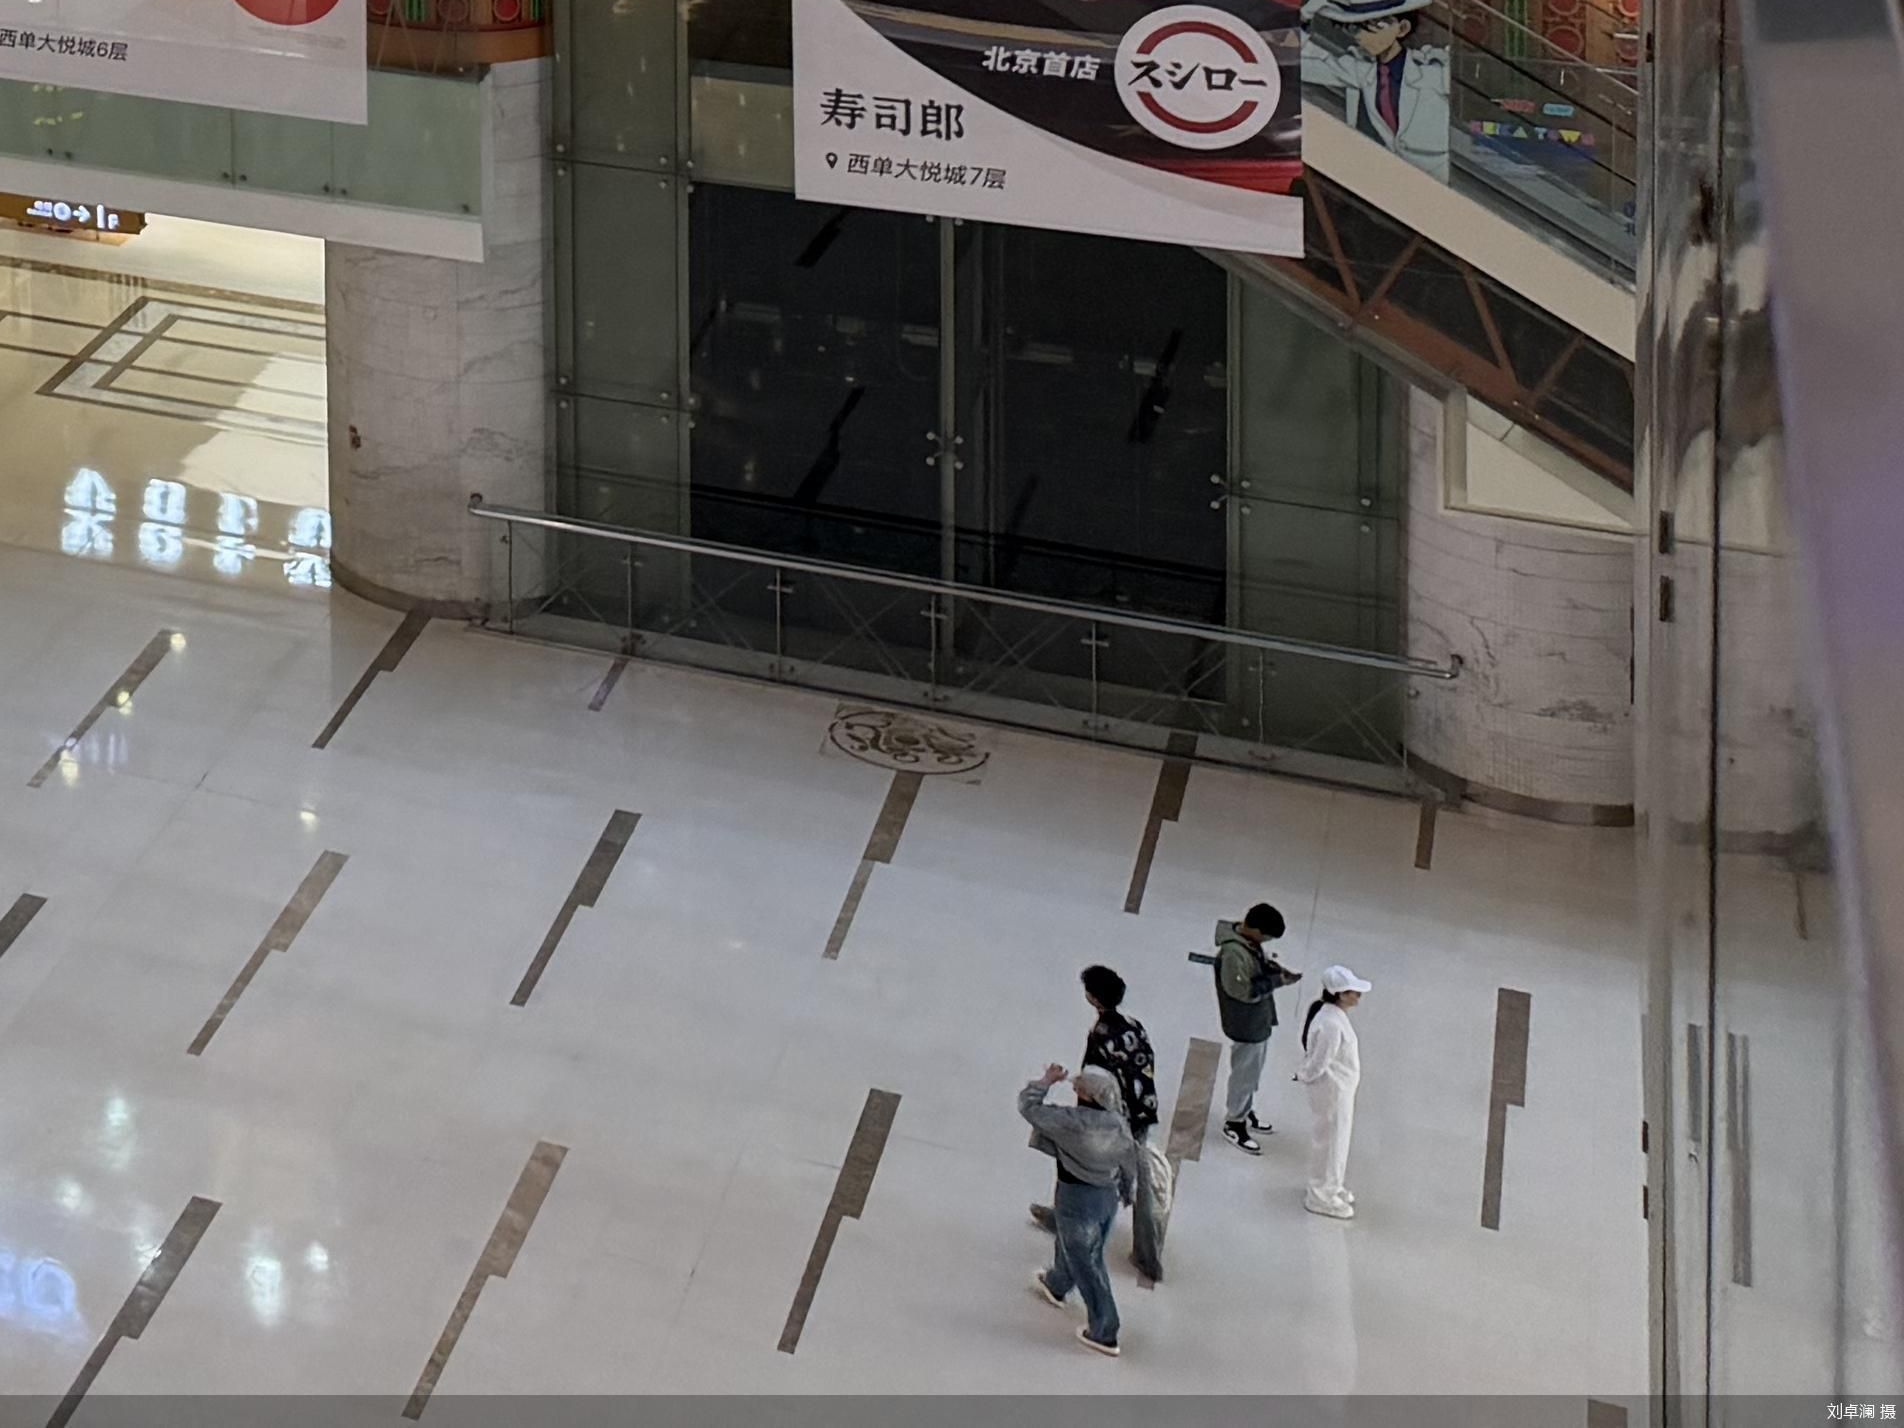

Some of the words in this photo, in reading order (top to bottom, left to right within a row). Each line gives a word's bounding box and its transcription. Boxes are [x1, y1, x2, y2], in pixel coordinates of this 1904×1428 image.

[981, 45, 1101, 82] 北京首店
[1127, 58, 1268, 94] スシロー
[818, 87, 966, 141] 寿司郎
[847, 152, 1008, 191] 西单大悦城7层
